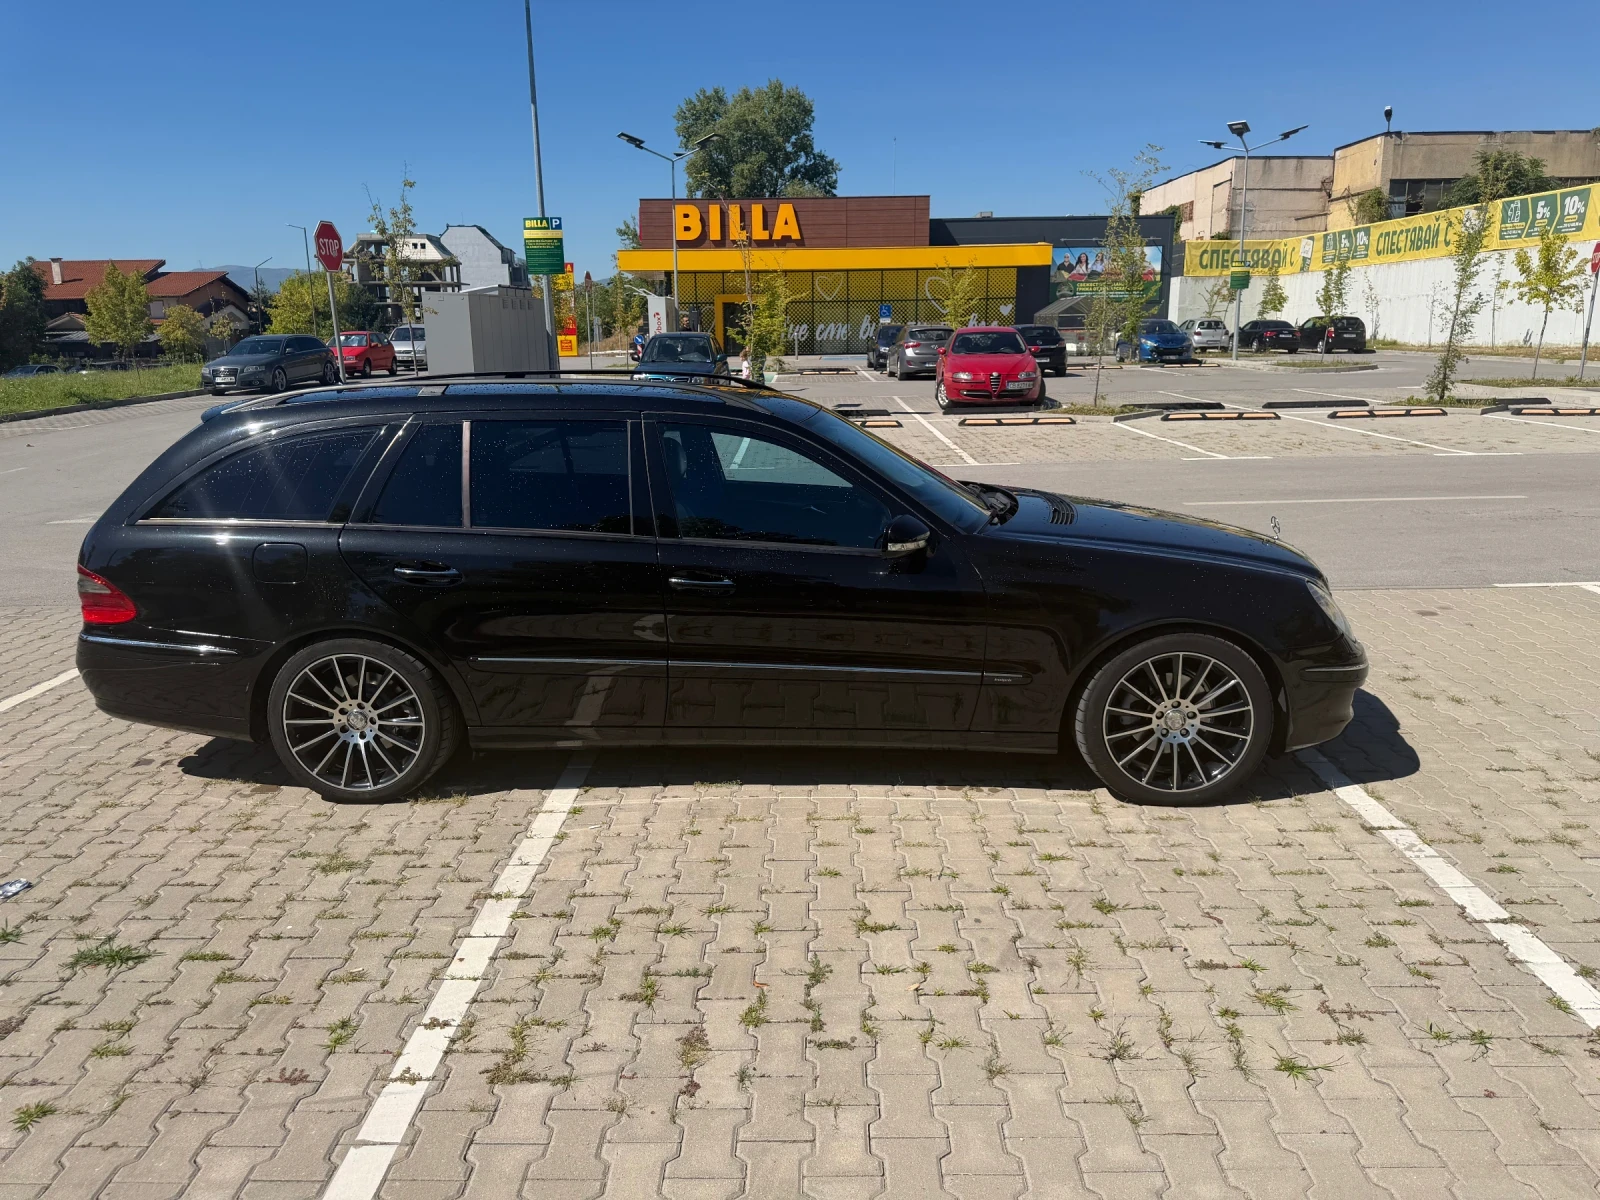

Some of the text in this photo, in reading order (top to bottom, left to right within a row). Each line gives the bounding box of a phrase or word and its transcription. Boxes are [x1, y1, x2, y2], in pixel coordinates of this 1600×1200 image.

[1536, 201, 1550, 219] 5%
[1564, 196, 1584, 215] 10%
[525, 219, 548, 228] BILLA
[552, 218, 560, 228] P
[675, 203, 801, 241] BILLA
[1356, 231, 1369, 246] 10%
[1376, 215, 1441, 257] СПЕСТЯВАЙ
[319, 238, 340, 257] STOP
[1199, 242, 1288, 270] СПЕСТЯВАЙ
